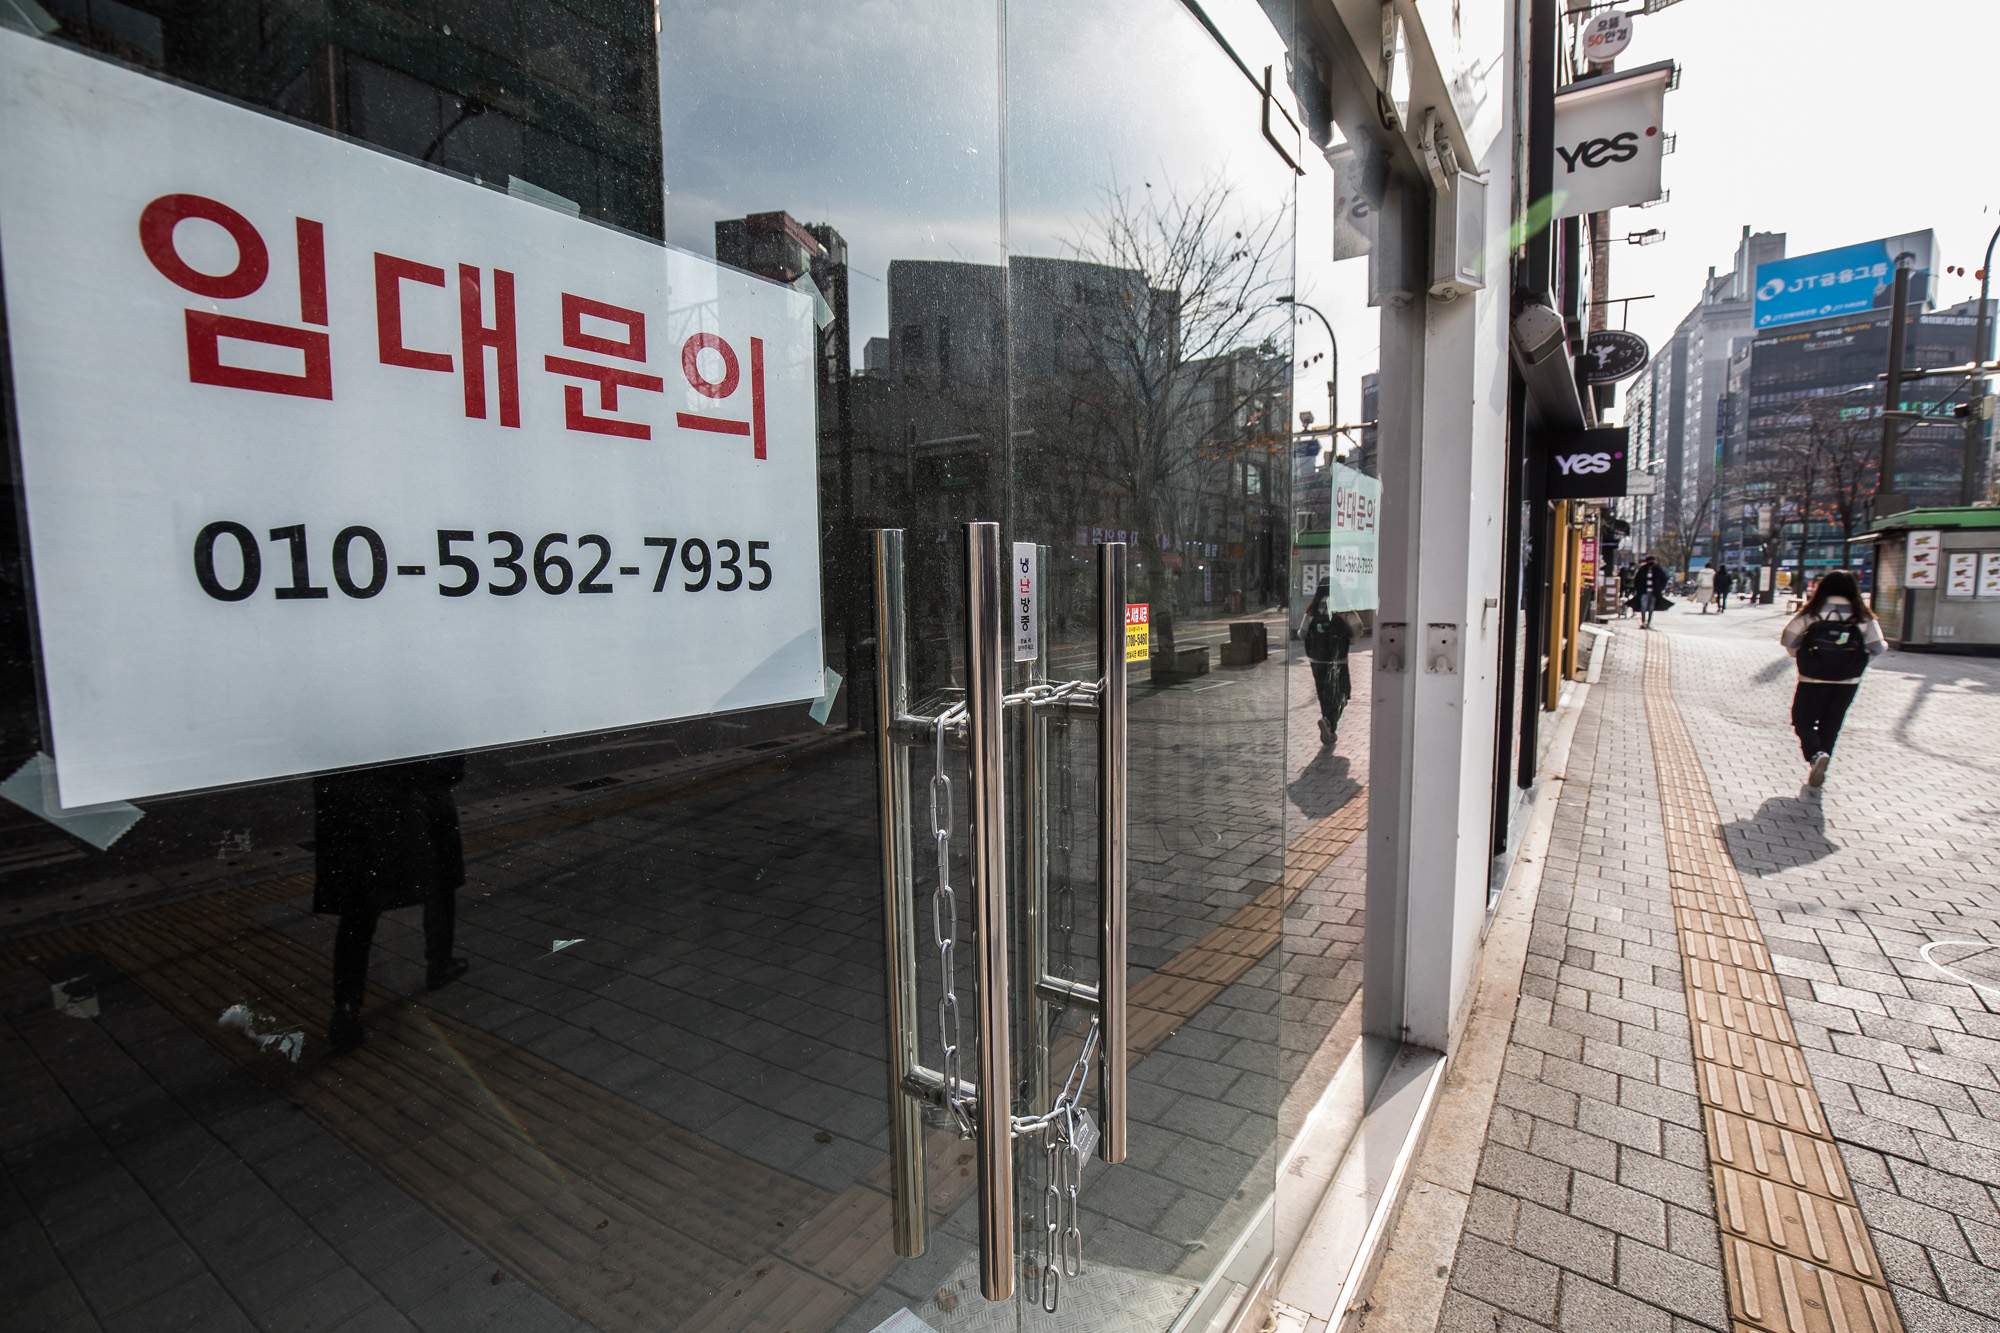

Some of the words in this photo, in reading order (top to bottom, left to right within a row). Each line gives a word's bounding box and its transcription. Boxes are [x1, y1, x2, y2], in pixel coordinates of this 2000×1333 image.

[1587, 28, 1628, 48] 50안경
[1787, 261, 1889, 293] JT금융그룹
[139, 193, 768, 461] 임대문의
[1336, 486, 1376, 535] 임대문의
[193, 520, 773, 602] 010-5362-7935
